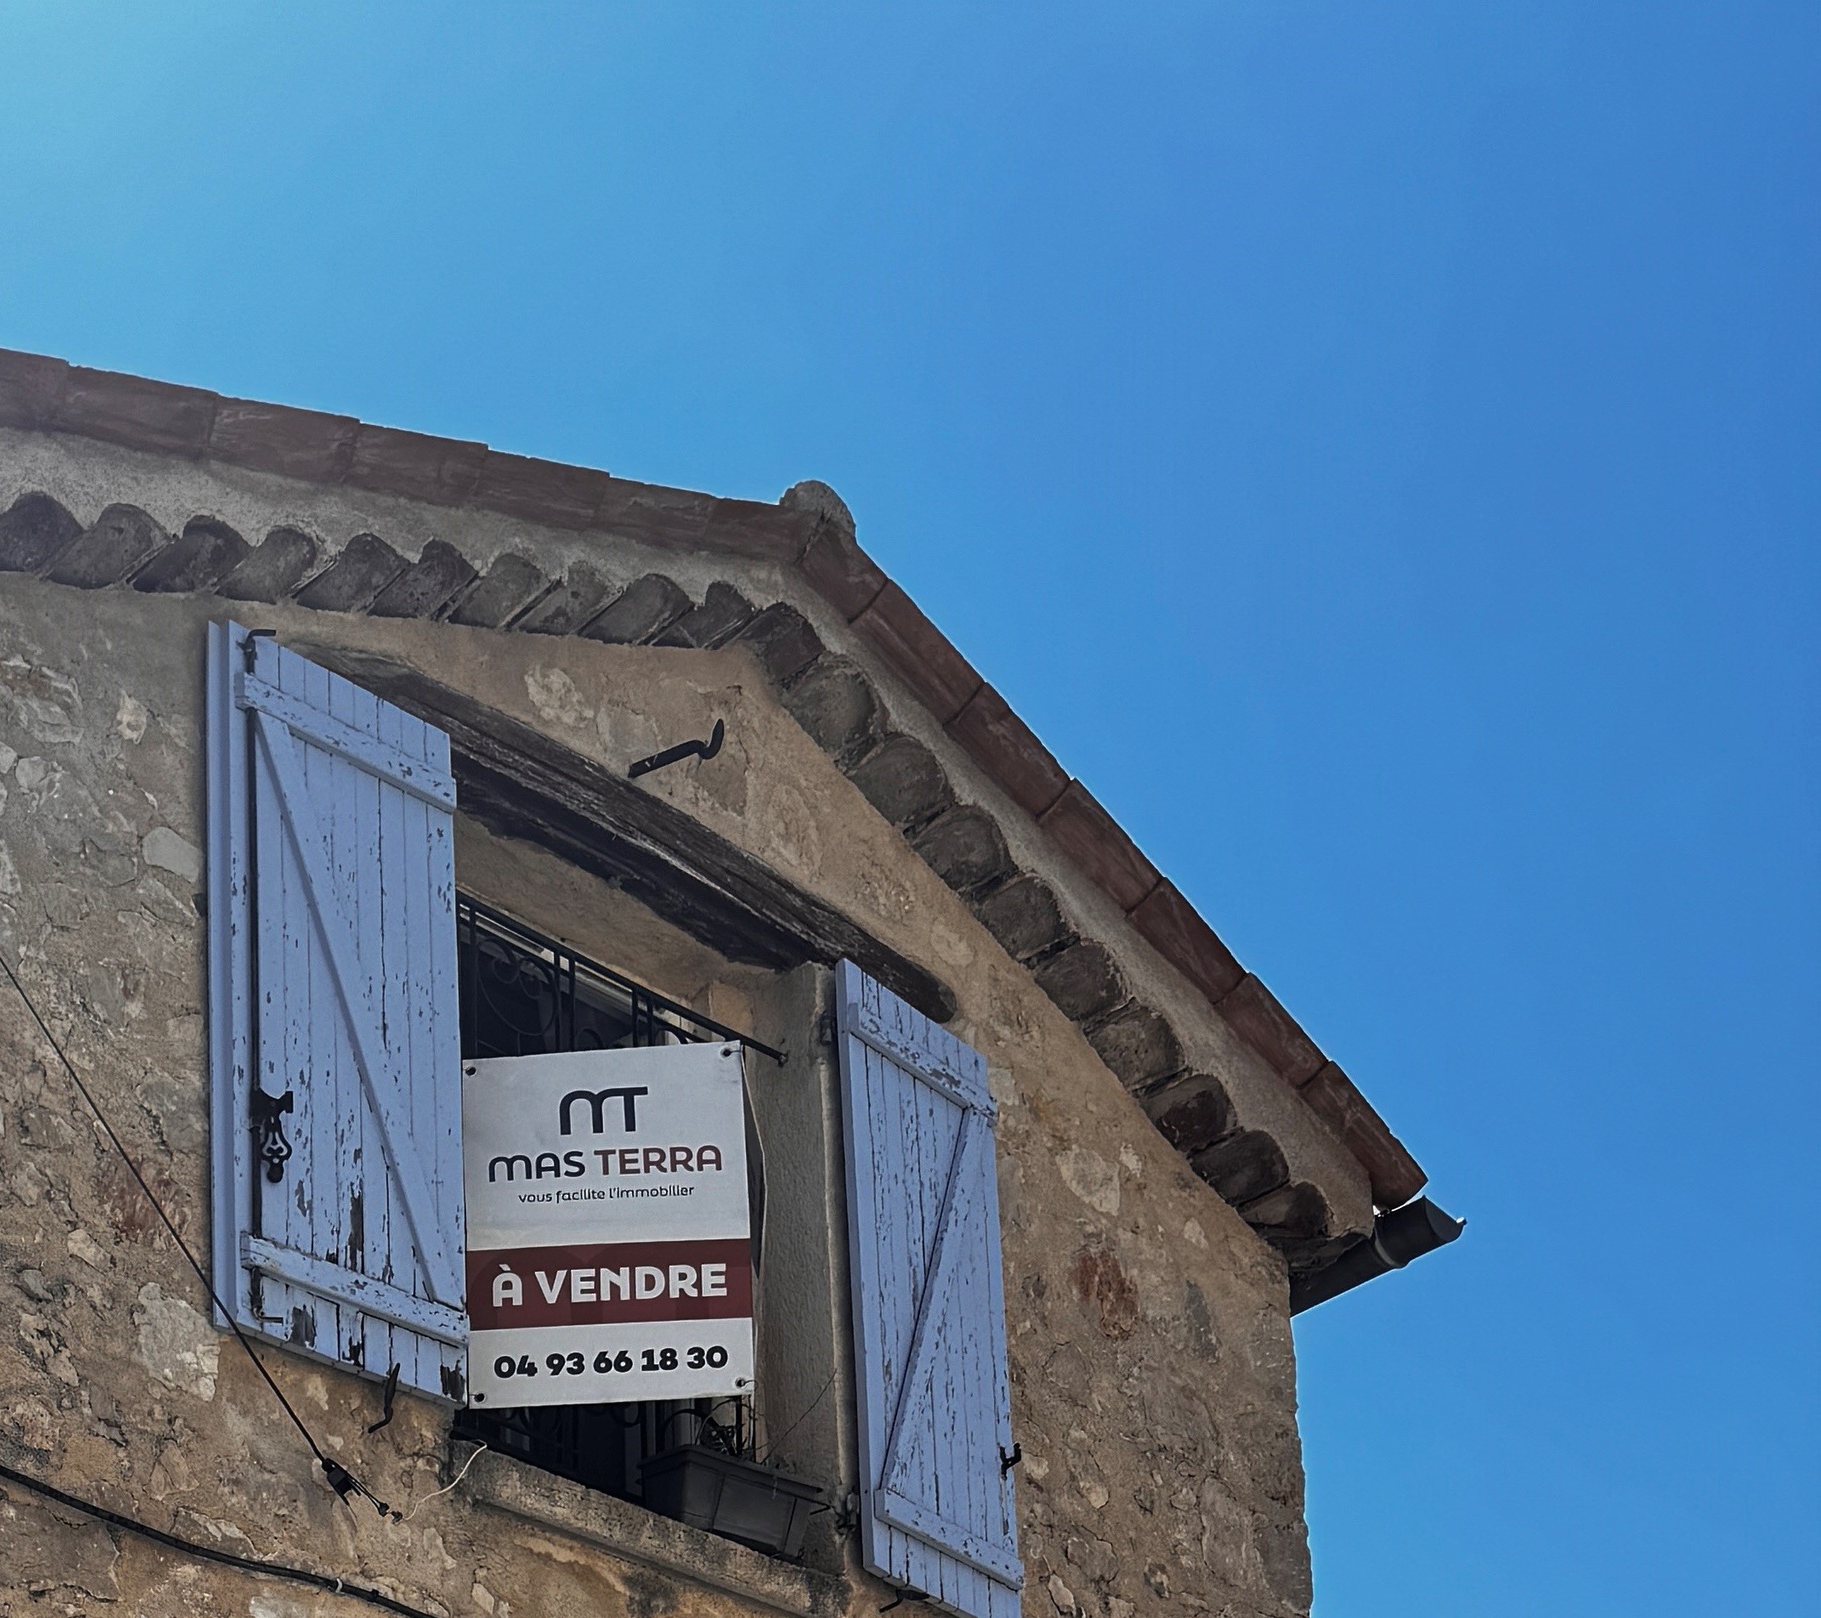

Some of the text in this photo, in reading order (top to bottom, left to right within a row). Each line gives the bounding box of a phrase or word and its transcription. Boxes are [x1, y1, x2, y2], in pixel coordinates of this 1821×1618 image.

[488, 1144, 723, 1183] MAS TERRA
[518, 1185, 695, 1204] vous facilite l'immobilier
[492, 1262, 728, 1307] À VENDRE
[493, 1345, 729, 1379] 04 93 66 18 30
